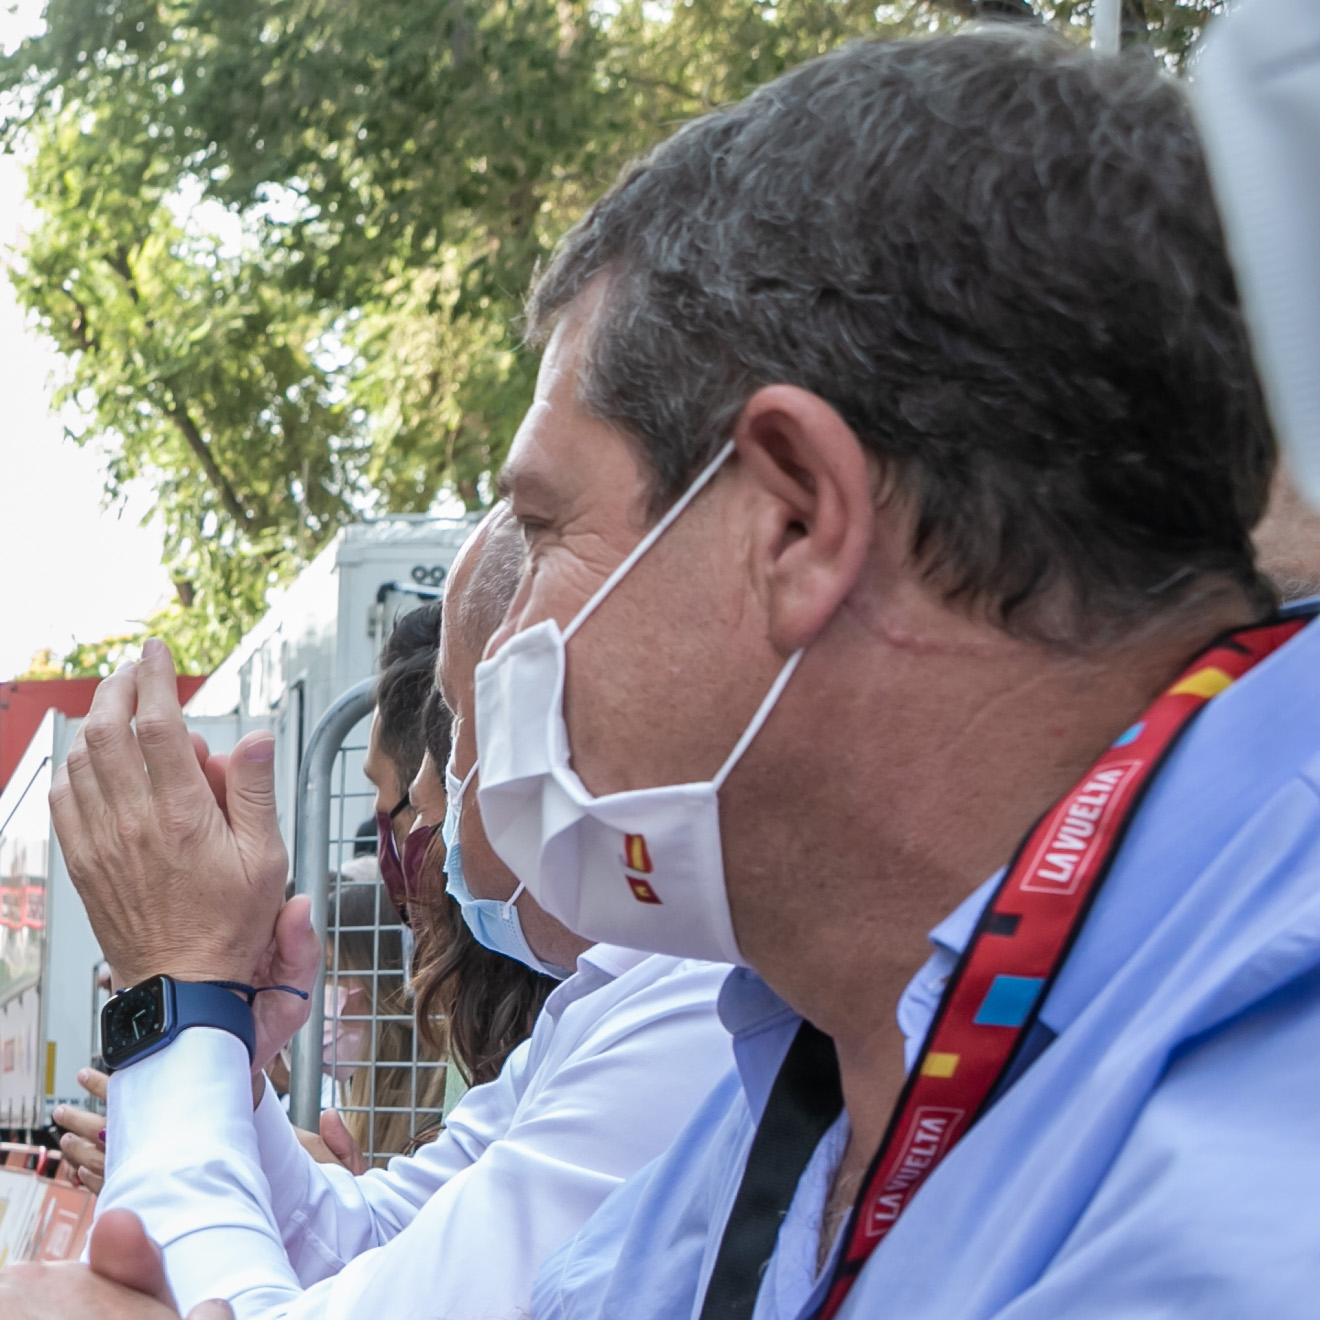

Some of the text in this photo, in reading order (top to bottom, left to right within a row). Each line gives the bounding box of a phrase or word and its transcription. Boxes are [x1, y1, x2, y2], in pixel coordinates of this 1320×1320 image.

[1036, 769, 1124, 883] LA VUELTA
[885, 1117, 948, 1191] VUELTA
